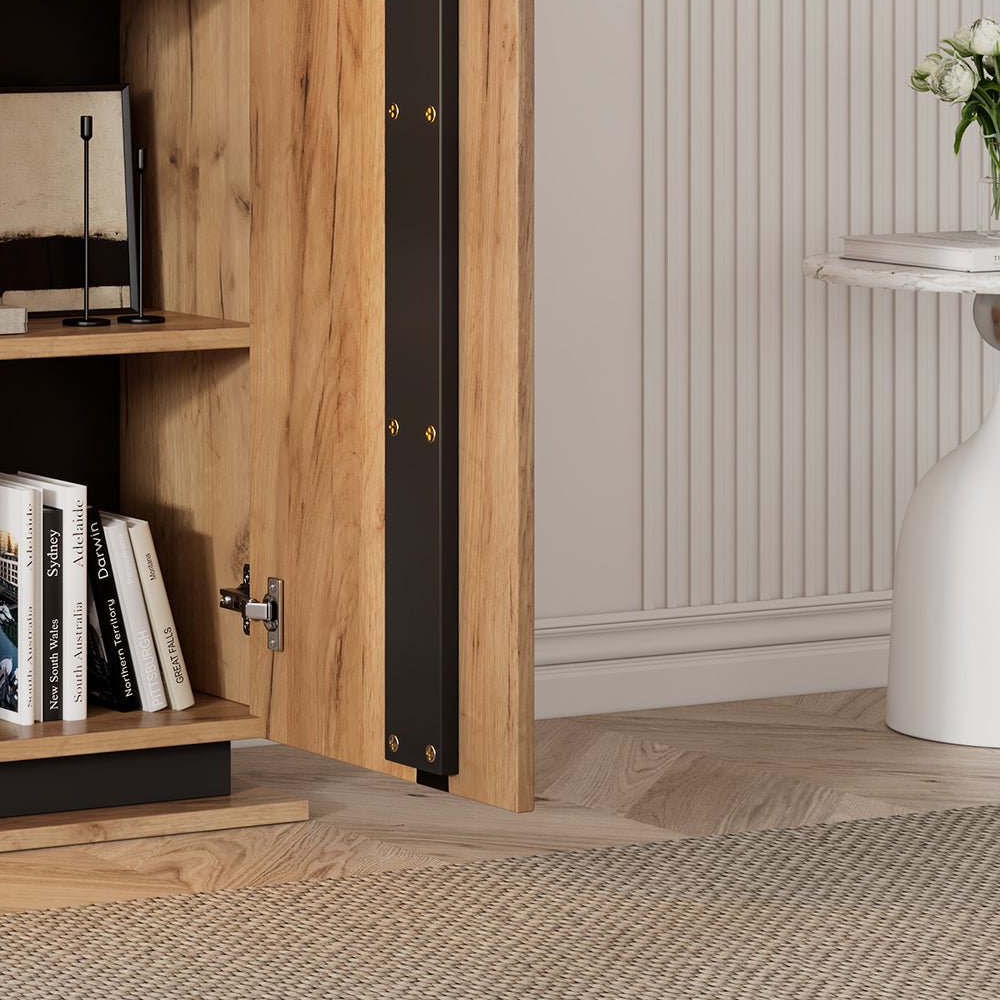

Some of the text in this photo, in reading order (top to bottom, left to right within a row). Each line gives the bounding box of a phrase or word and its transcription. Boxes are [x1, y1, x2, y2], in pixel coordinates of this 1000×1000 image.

[46, 529, 61, 577] Sydney
[72, 499, 84, 568] Adelaide
[90, 521, 109, 580] Darwin
[145, 552, 157, 581] Montana
[49, 618, 59, 711] New South Wales
[73, 601, 83, 703] South Australia
[107, 598, 134, 698] Northern Territory
[137, 629, 163, 707] PITTSBURGH
[164, 626, 184, 684] GREAT FALLS
